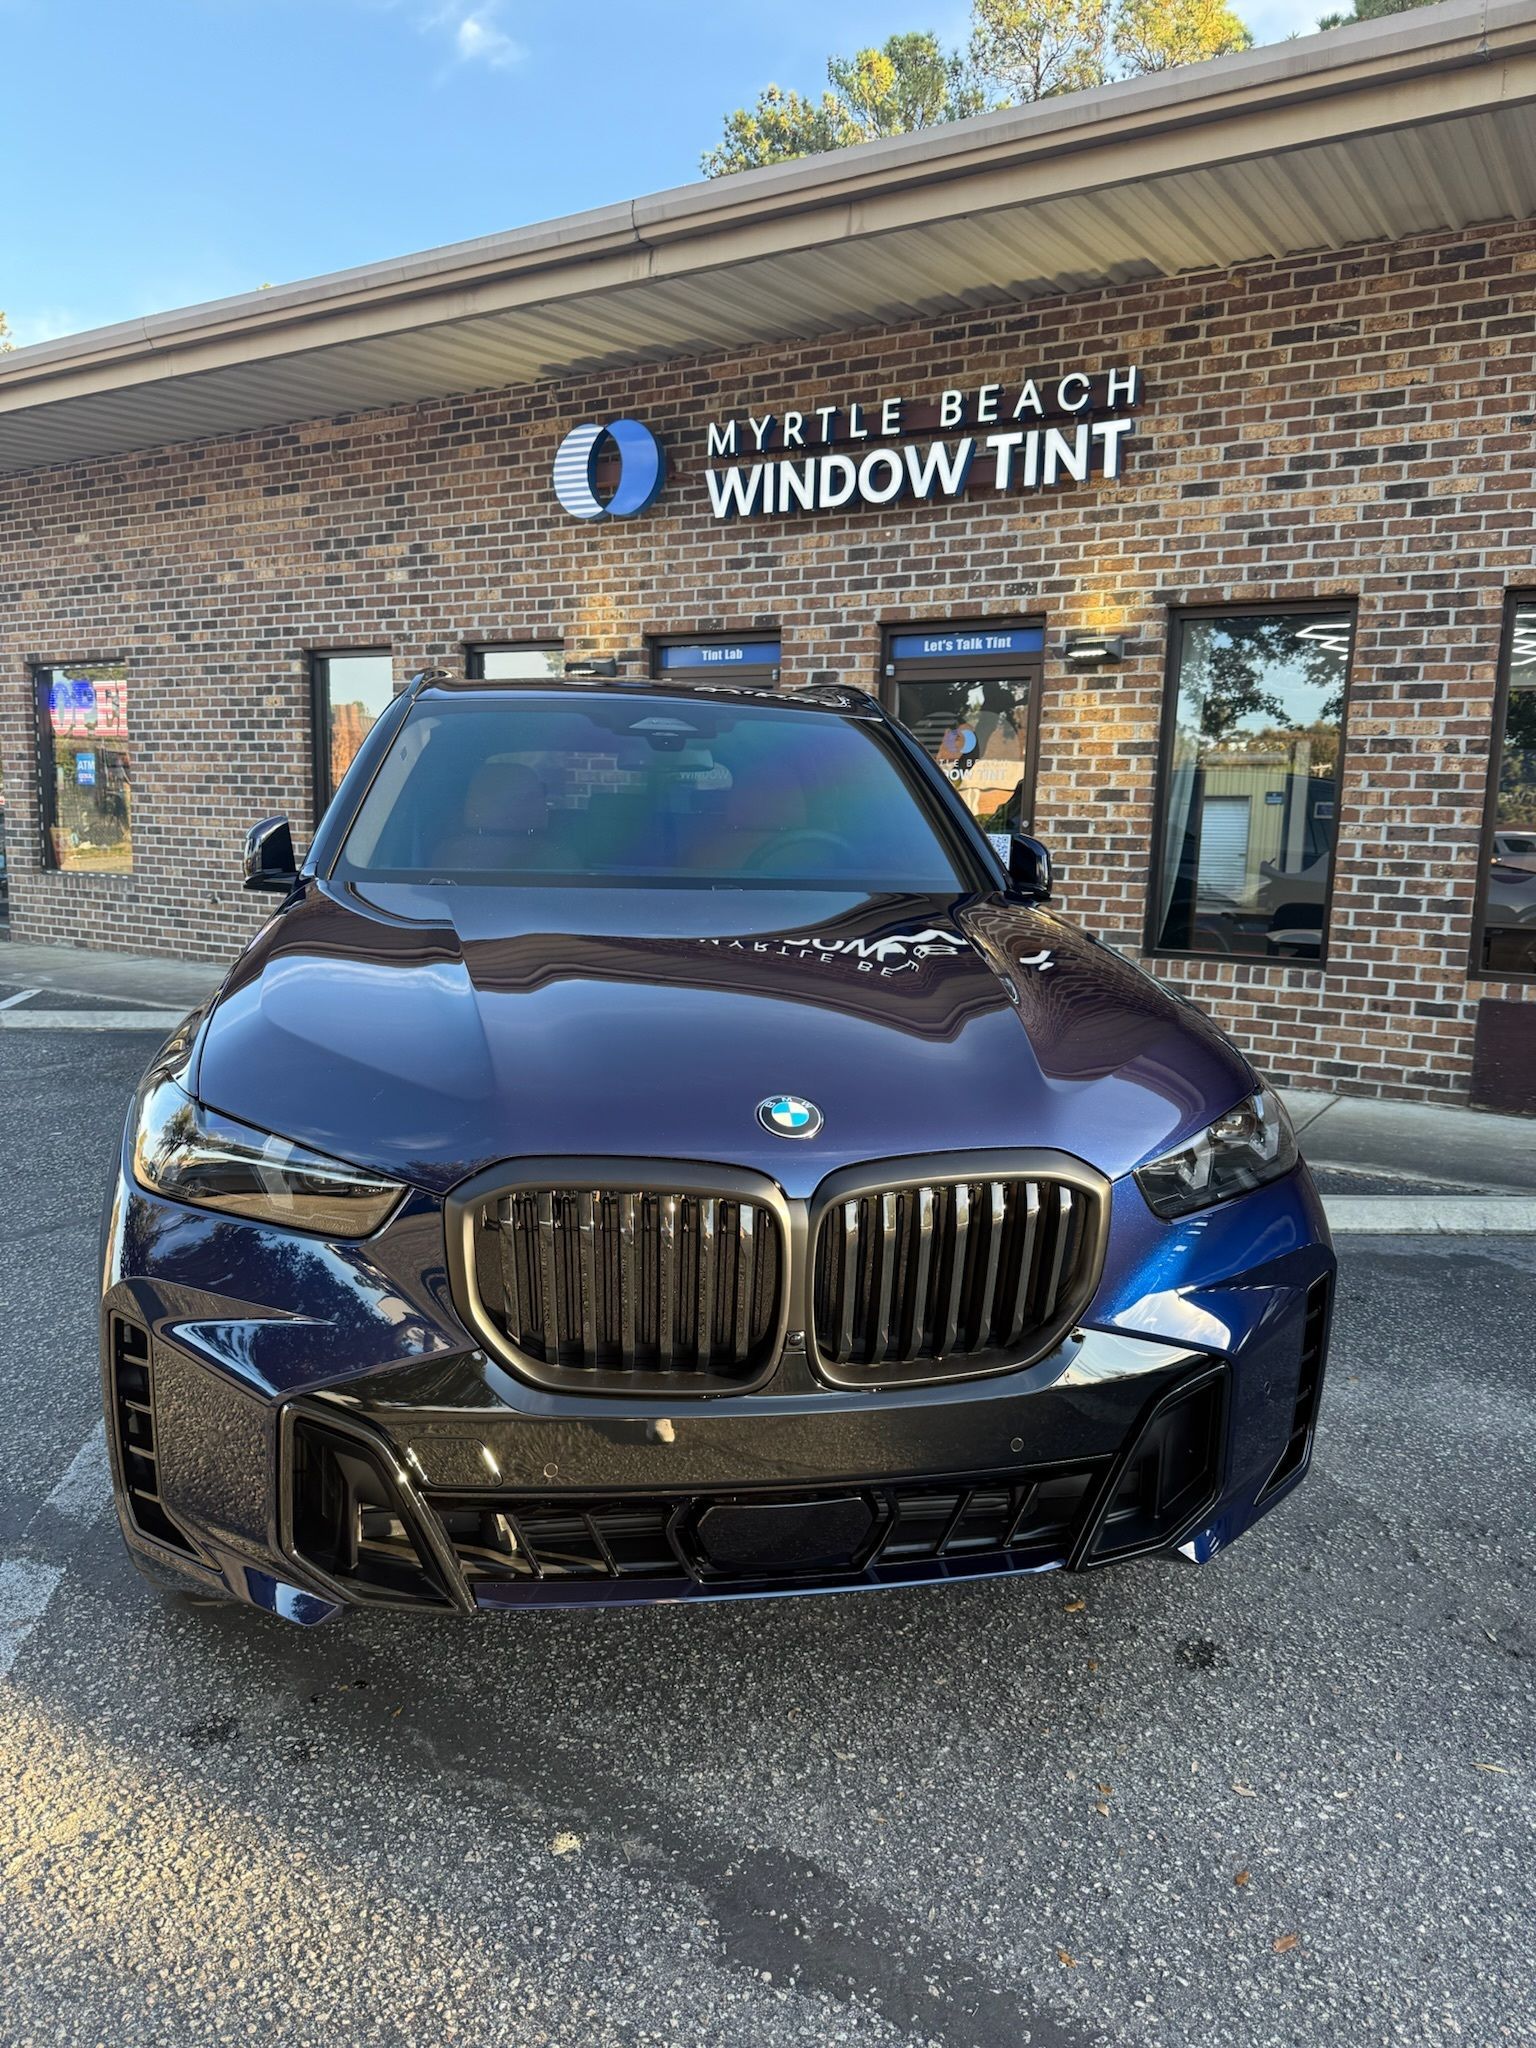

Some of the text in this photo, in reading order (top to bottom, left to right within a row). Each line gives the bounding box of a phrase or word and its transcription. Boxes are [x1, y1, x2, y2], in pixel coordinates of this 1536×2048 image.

[707, 365, 1137, 456] MYRTLE BEACH
[705, 418, 1132, 519] WINDOW TINT
[924, 636, 1012, 652] Let's Talk Tint
[702, 648, 743, 661] Tint Lab
[77, 760, 95, 771] ATM
